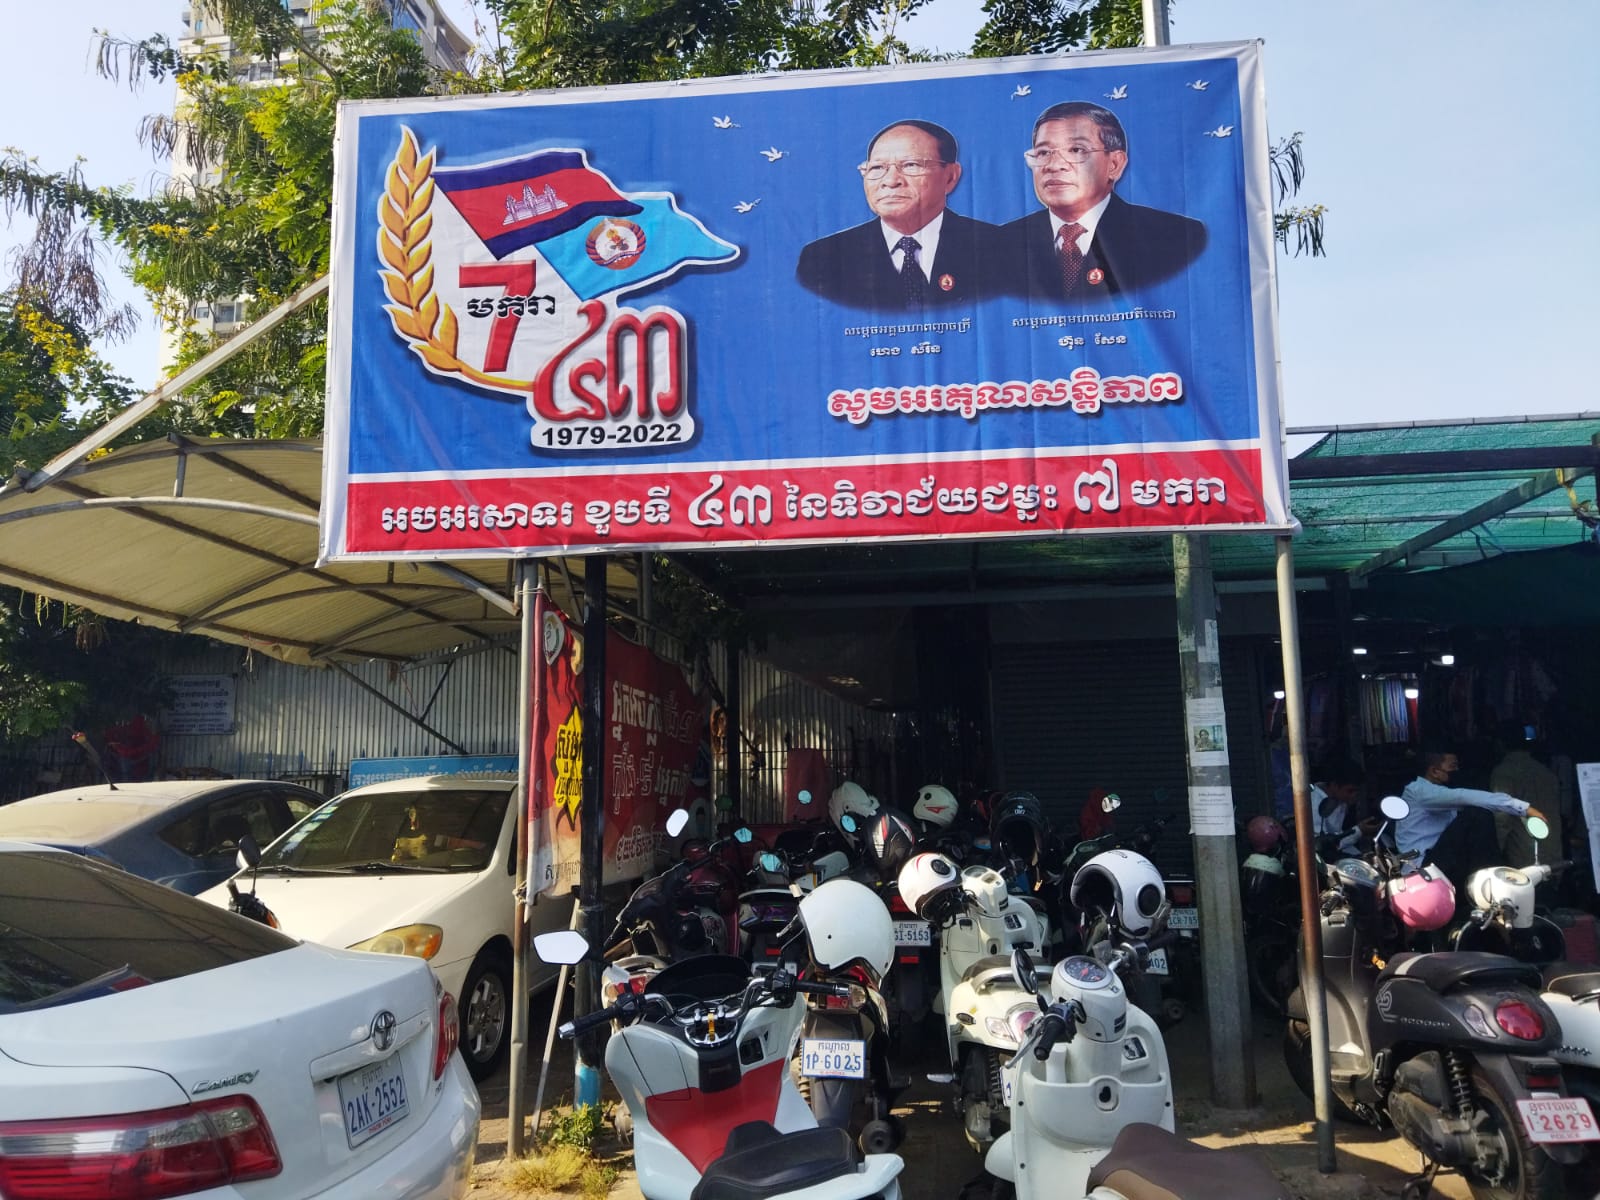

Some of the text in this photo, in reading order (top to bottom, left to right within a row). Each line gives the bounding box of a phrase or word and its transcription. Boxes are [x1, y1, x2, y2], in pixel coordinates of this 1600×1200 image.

[458, 258, 536, 373] 7
[466, 294, 557, 320] មករា
[534, 299, 684, 422] ៤៣
[829, 368, 1182, 423] សូមអរគុណសន្តិភាព
[540, 423, 683, 447] 1979-2022
[381, 499, 573, 533] អបអរសាទរ
[584, 486, 671, 535] ខួបទី
[687, 473, 773, 527] ៤៣
[1073, 457, 1120, 513] ៧
[1129, 476, 1227, 507] មករា
[346, 1075, 406, 1134] 2AK-2552
